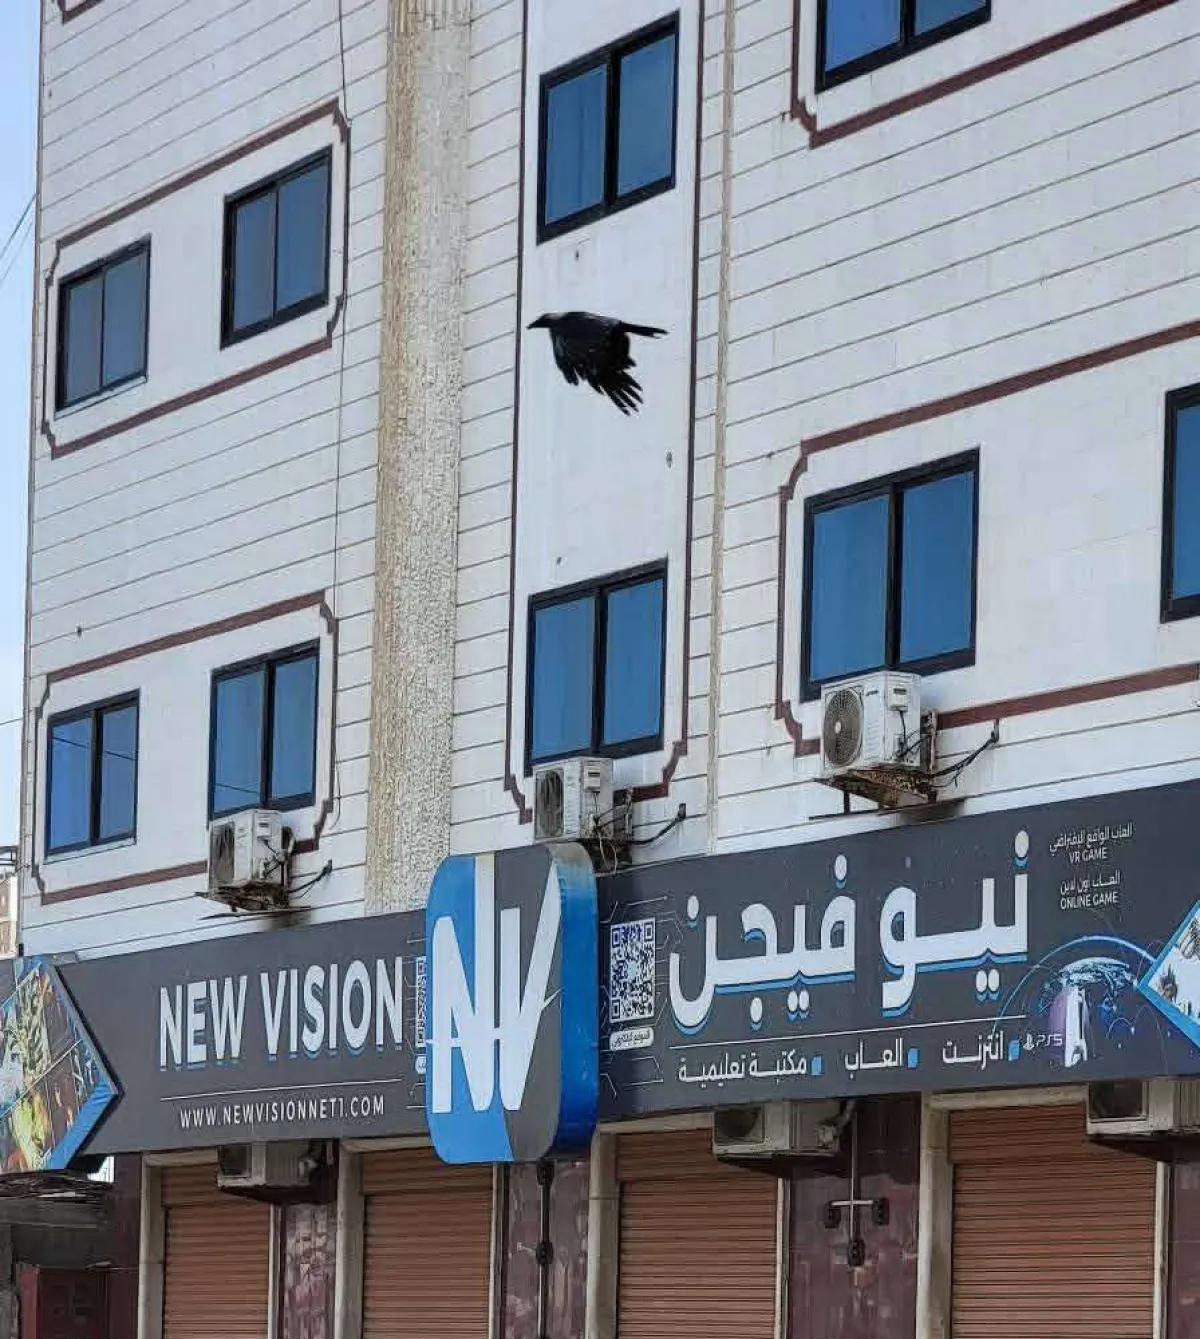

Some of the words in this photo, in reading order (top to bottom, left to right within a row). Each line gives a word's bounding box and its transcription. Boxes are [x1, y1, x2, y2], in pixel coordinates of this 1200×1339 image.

[1069, 851, 1081, 864] VR
[1081, 846, 1108, 862] GAME
[1060, 894, 1091, 910] ONLINE
[1092, 891, 1119, 906] GAME
[879, 830, 1028, 1012] نيو
[669, 853, 856, 1030] فيجن
[159, 973, 248, 1070] NEW
[260, 955, 404, 1058] VISION
[1036, 1033, 1063, 1047] PS5
[677, 1051, 747, 1089] تعليمية
[749, 1048, 807, 1086] مكتبة
[180, 1094, 385, 1129] WWW.NEWVISIONNET1.COM
